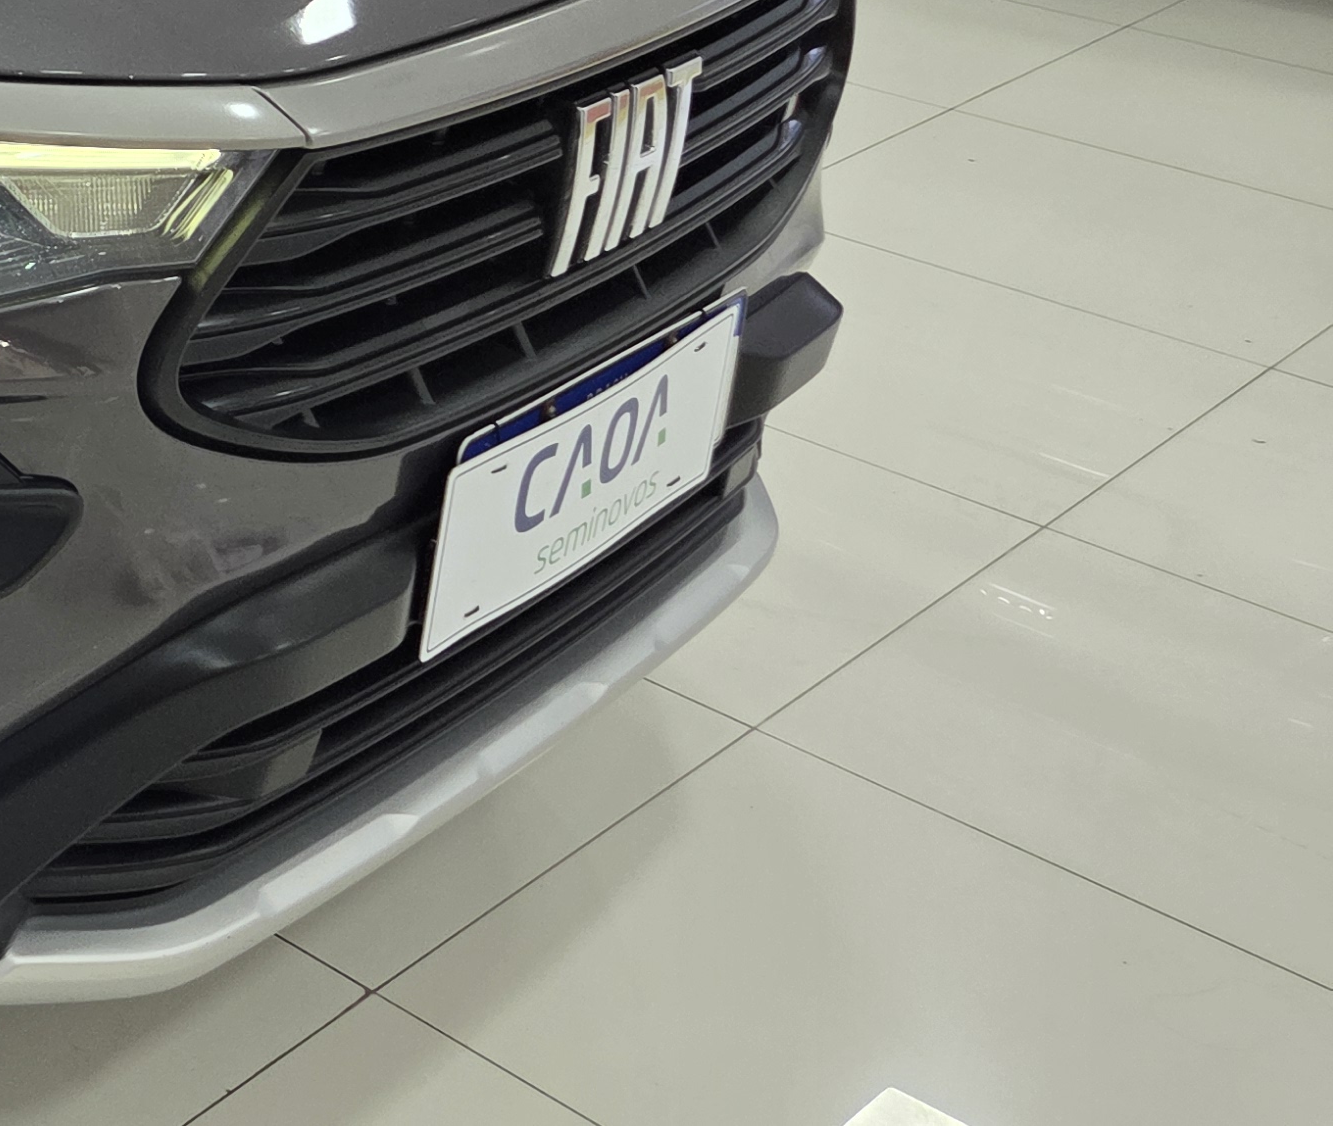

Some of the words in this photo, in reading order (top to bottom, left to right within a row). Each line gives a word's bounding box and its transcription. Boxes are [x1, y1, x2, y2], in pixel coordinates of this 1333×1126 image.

[550, 56, 703, 278] FIAT
[513, 373, 669, 534] CAOA
[533, 470, 660, 576] seminovos
